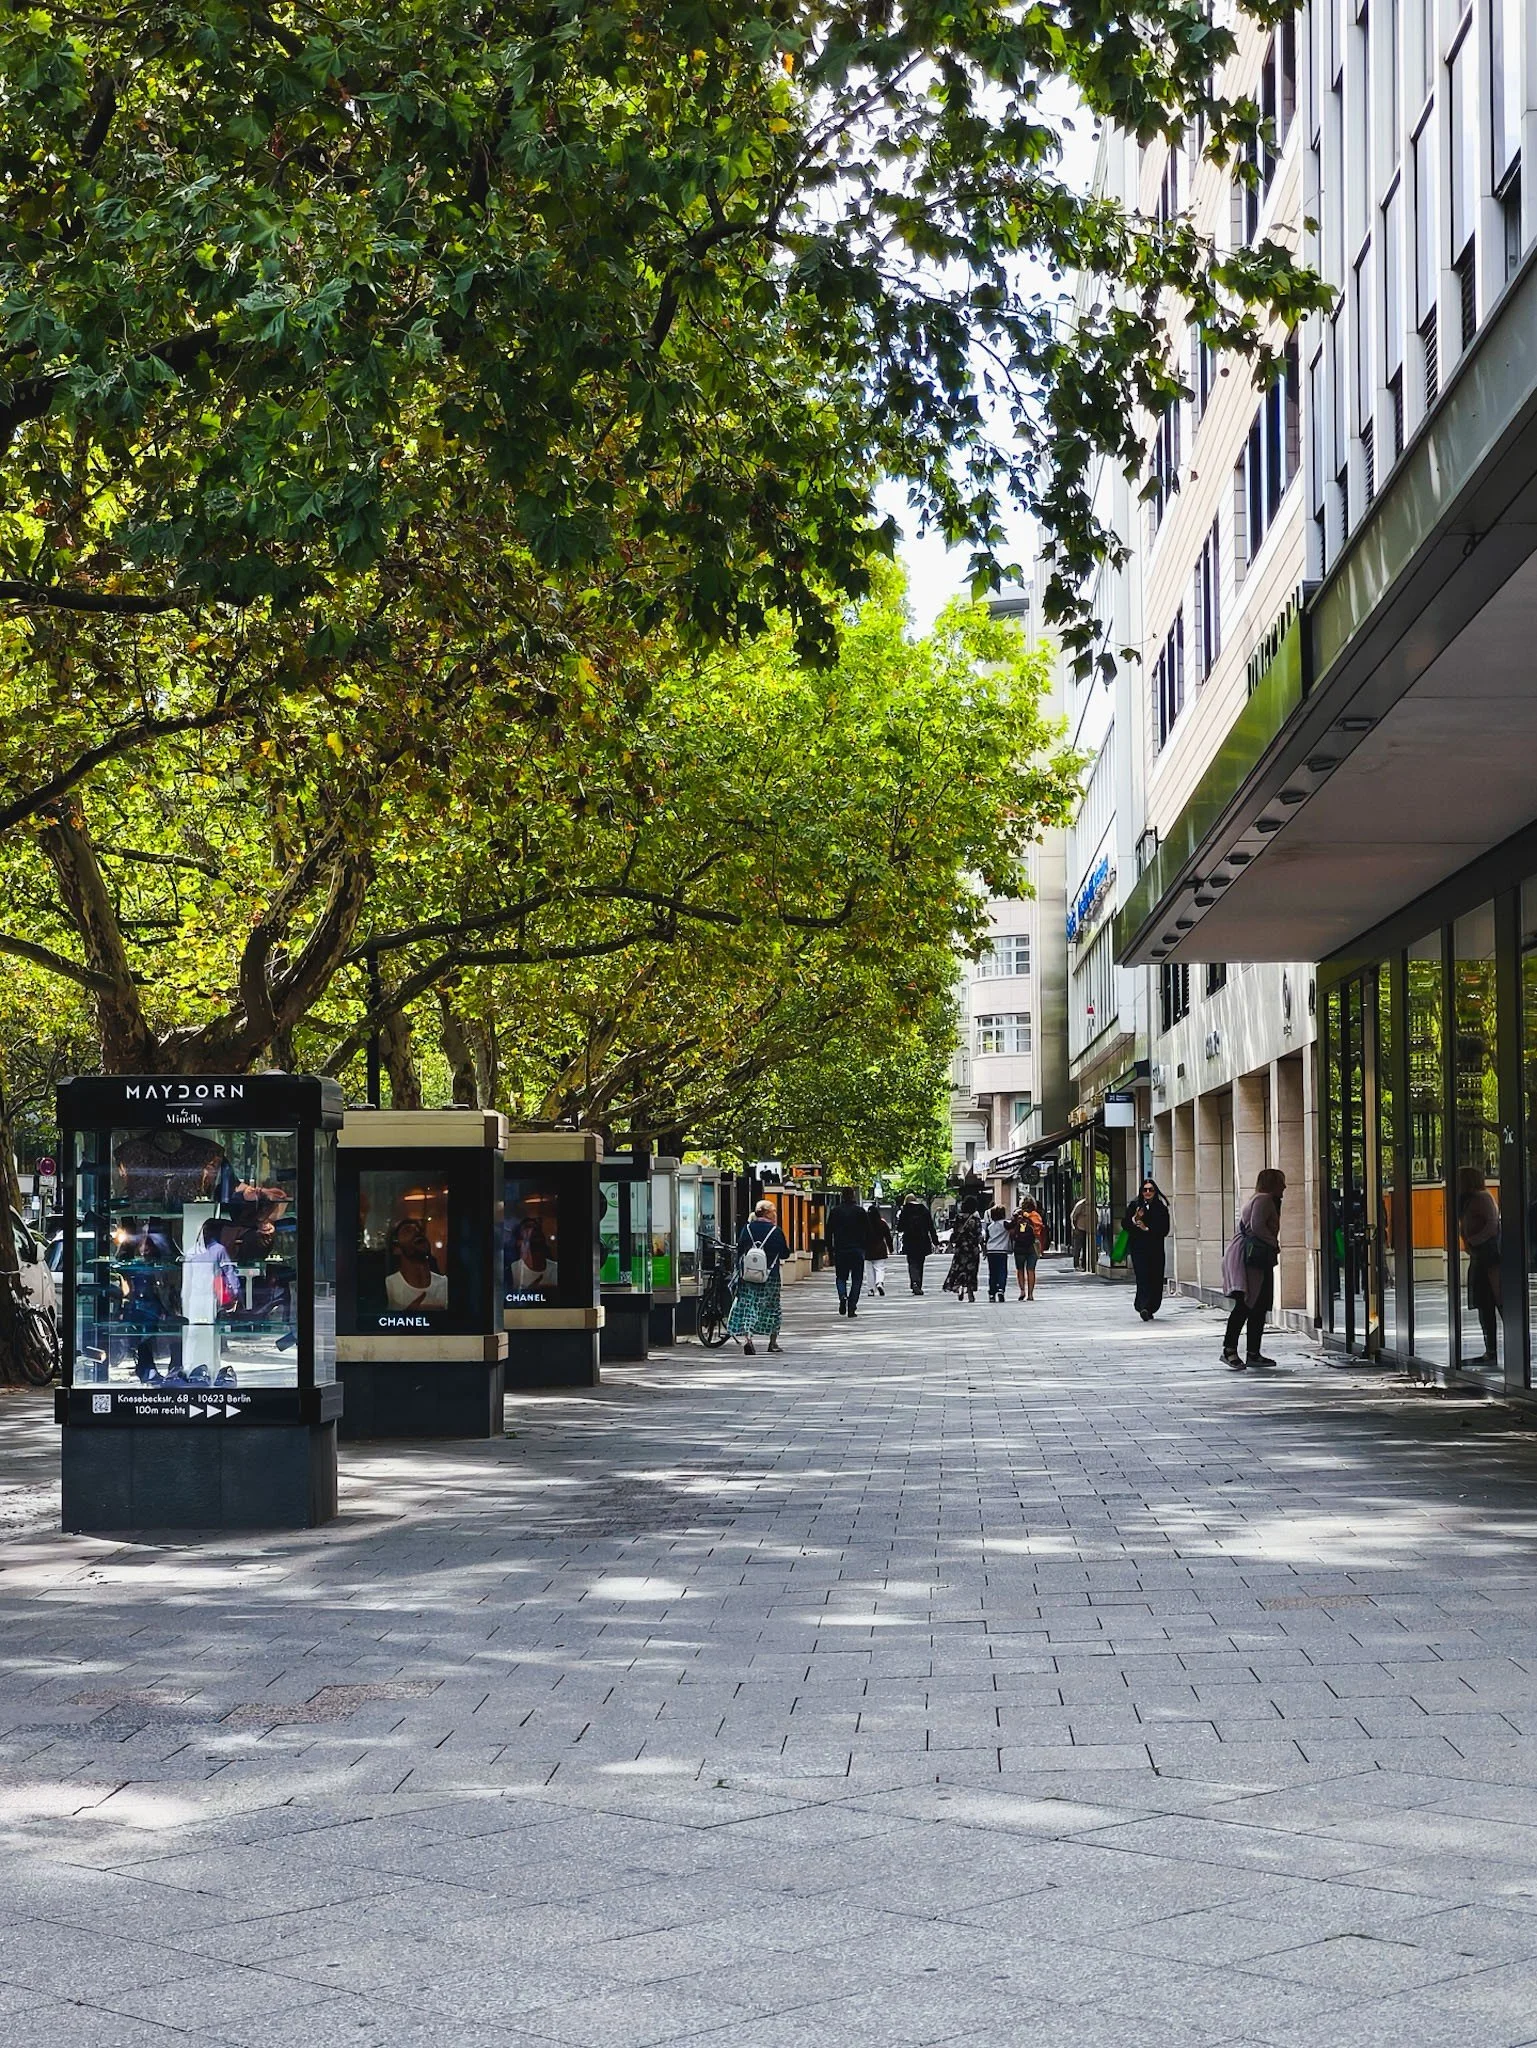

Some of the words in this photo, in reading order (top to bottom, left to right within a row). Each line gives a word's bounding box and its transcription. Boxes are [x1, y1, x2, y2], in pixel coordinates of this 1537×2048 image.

[126, 1084, 244, 1099] MAYDORN
[505, 1293, 547, 1302] CHANEL
[378, 1317, 430, 1327] CHANEL
[117, 1394, 175, 1403] Knesebeckstr.
[176, 1394, 189, 1403] 68
[198, 1394, 224, 1403] 10623
[226, 1394, 252, 1403] Berlin
[135, 1405, 159, 1415] 100m
[161, 1405, 186, 1415] rechts
